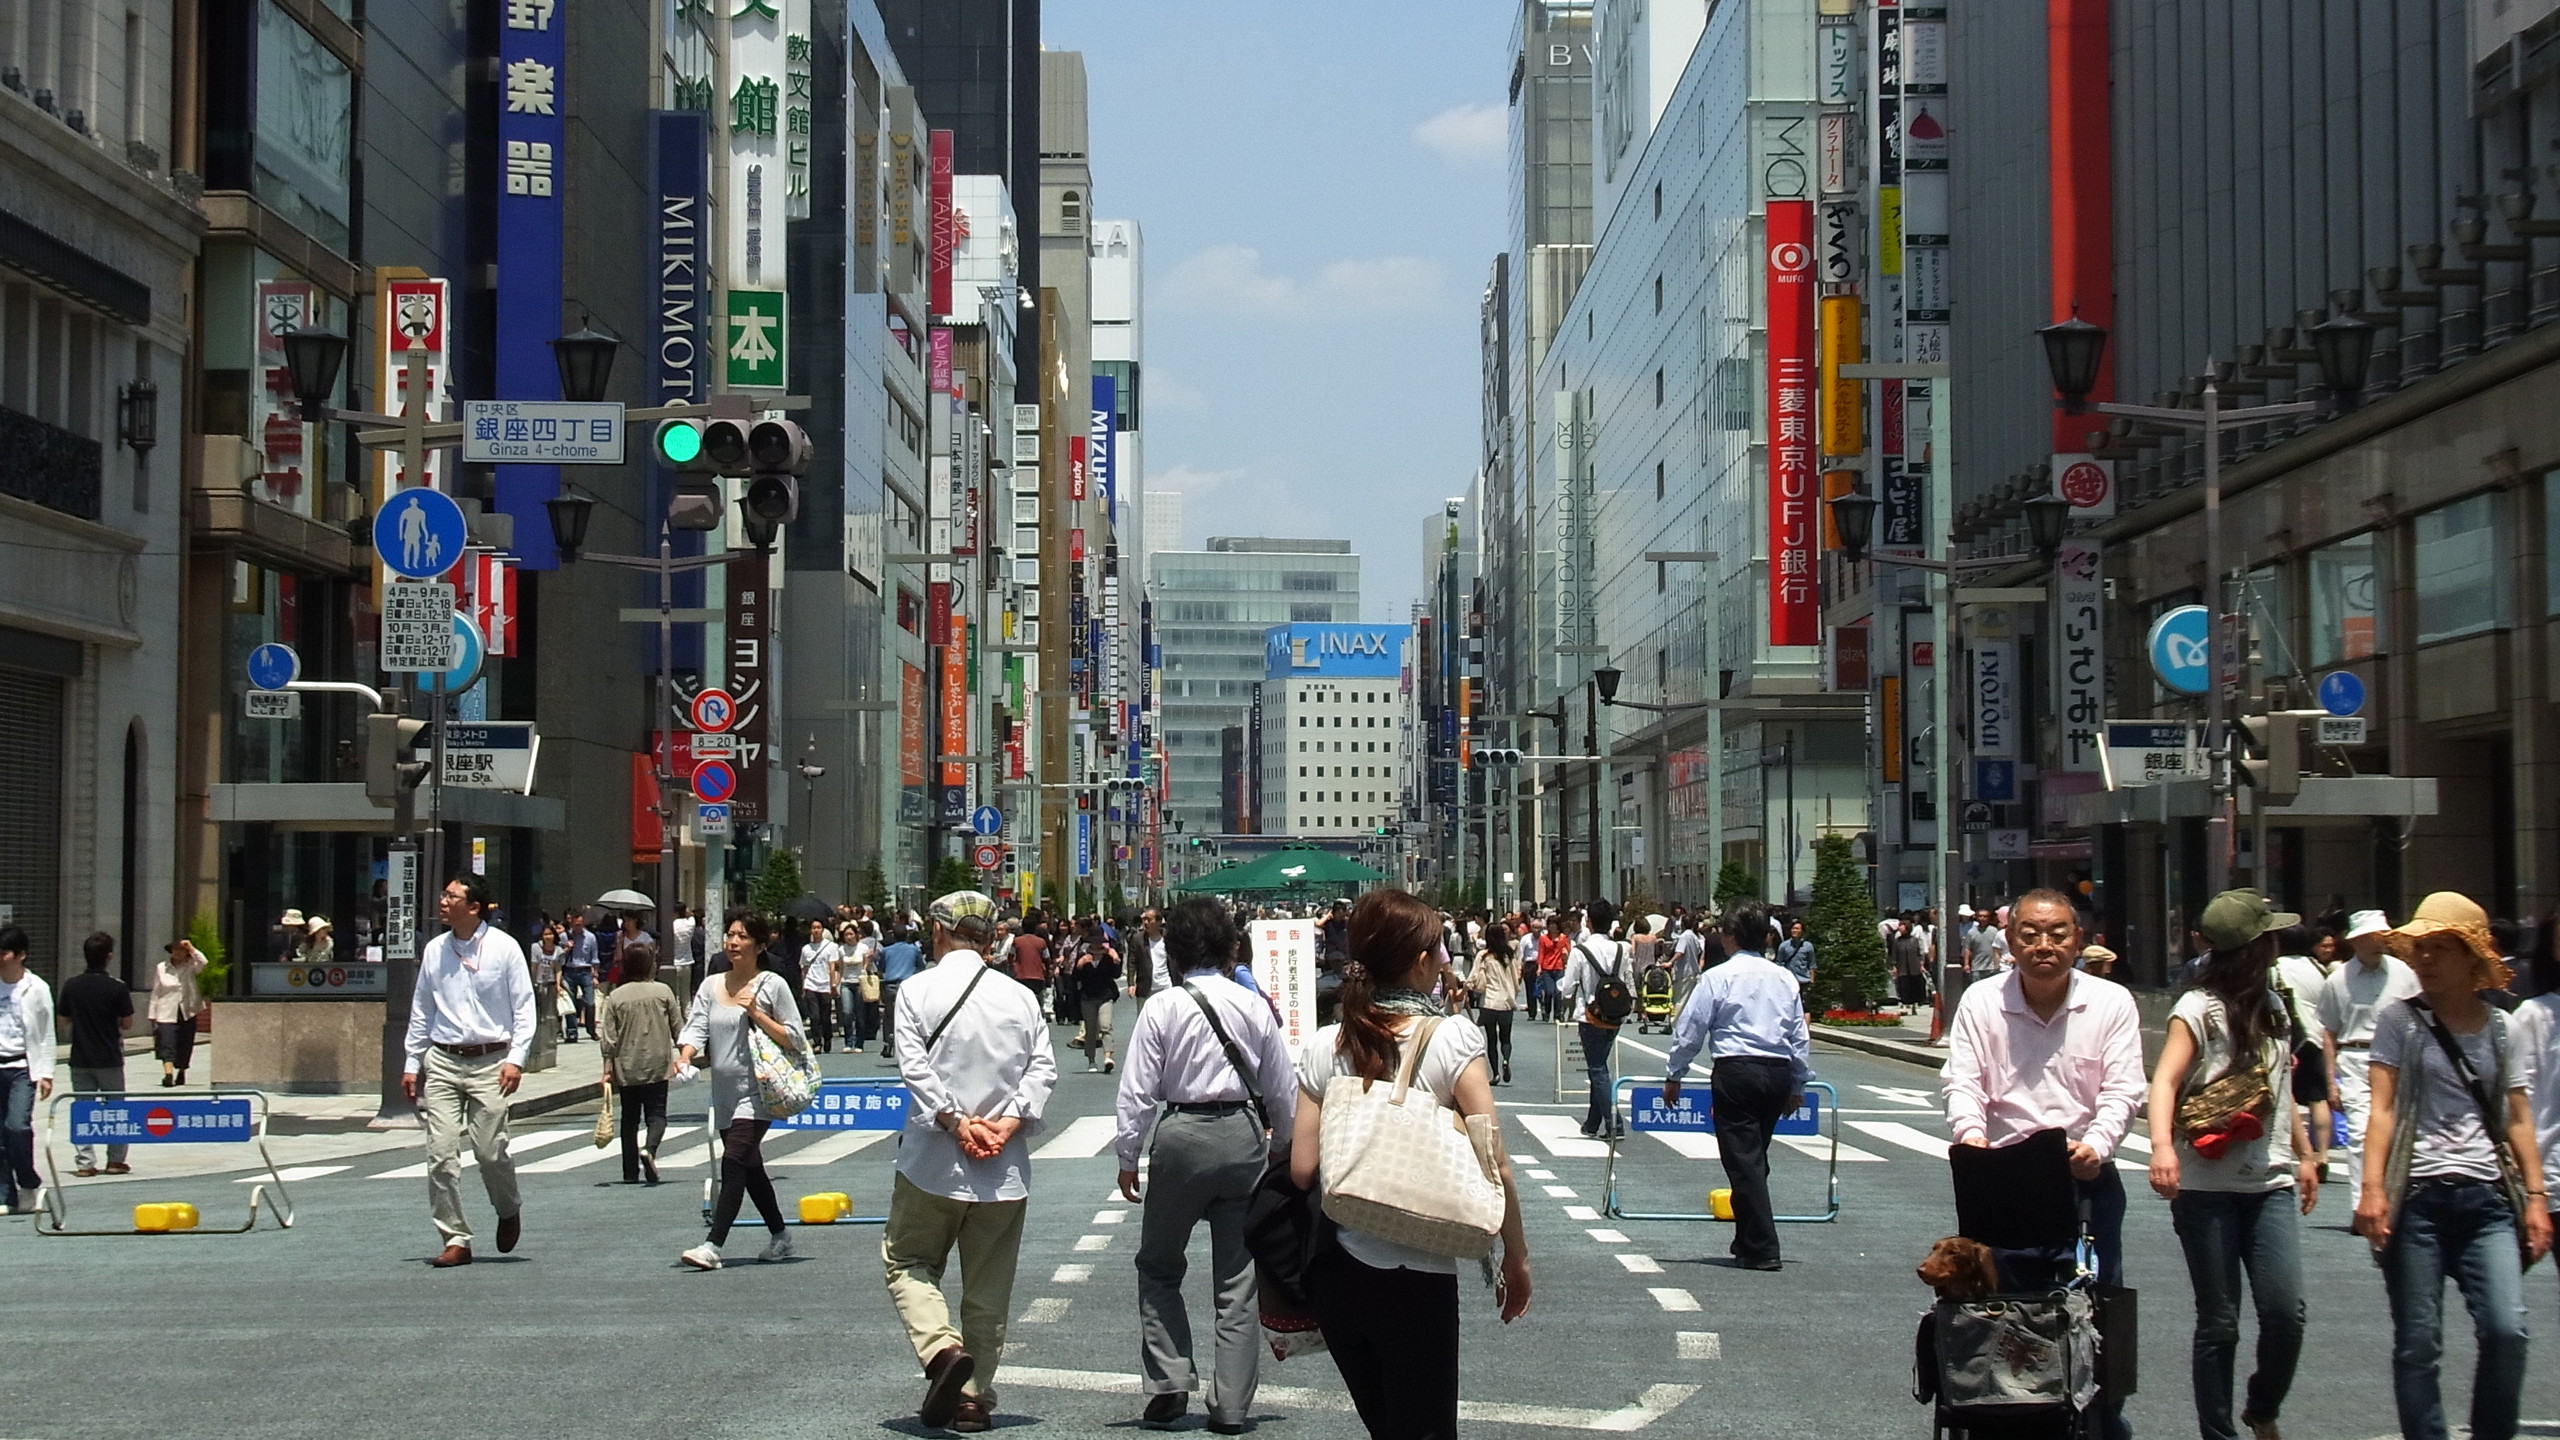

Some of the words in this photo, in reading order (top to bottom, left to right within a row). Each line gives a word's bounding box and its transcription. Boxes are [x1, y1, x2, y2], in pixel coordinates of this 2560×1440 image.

[1830, 28, 1848, 98] トップス
[786, 32, 811, 199] 教文館ビル
[1826, 118, 1840, 187] グラナータ
[748, 164, 762, 217] SINCE
[934, 194, 951, 273] TAMAYA
[1778, 274, 1805, 283] MUFG
[730, 306, 777, 371] 本
[476, 403, 518, 416] 中央区
[475, 417, 612, 441] 銀座四丁目
[489, 442, 528, 456] Ginza
[535, 443, 598, 456] 4-chome
[1779, 358, 1808, 604] 三菱東京UFJ銀行
[740, 591, 756, 627] 銀座
[1319, 632, 1388, 655] INAX
[1142, 662, 1151, 696] ALBION
[698, 737, 732, 748] 8-20
[2144, 752, 2204, 770] 銀座
[446, 773, 469, 783] inza
[981, 851, 994, 864] 50
[1288, 948, 1300, 1046] 歩行者天国での自転車の
[89, 1109, 129, 1123] 自転車
[1638, 1110, 1705, 1125] 乗入れ禁止
[76, 1123, 142, 1136] 乗入れ禁止
